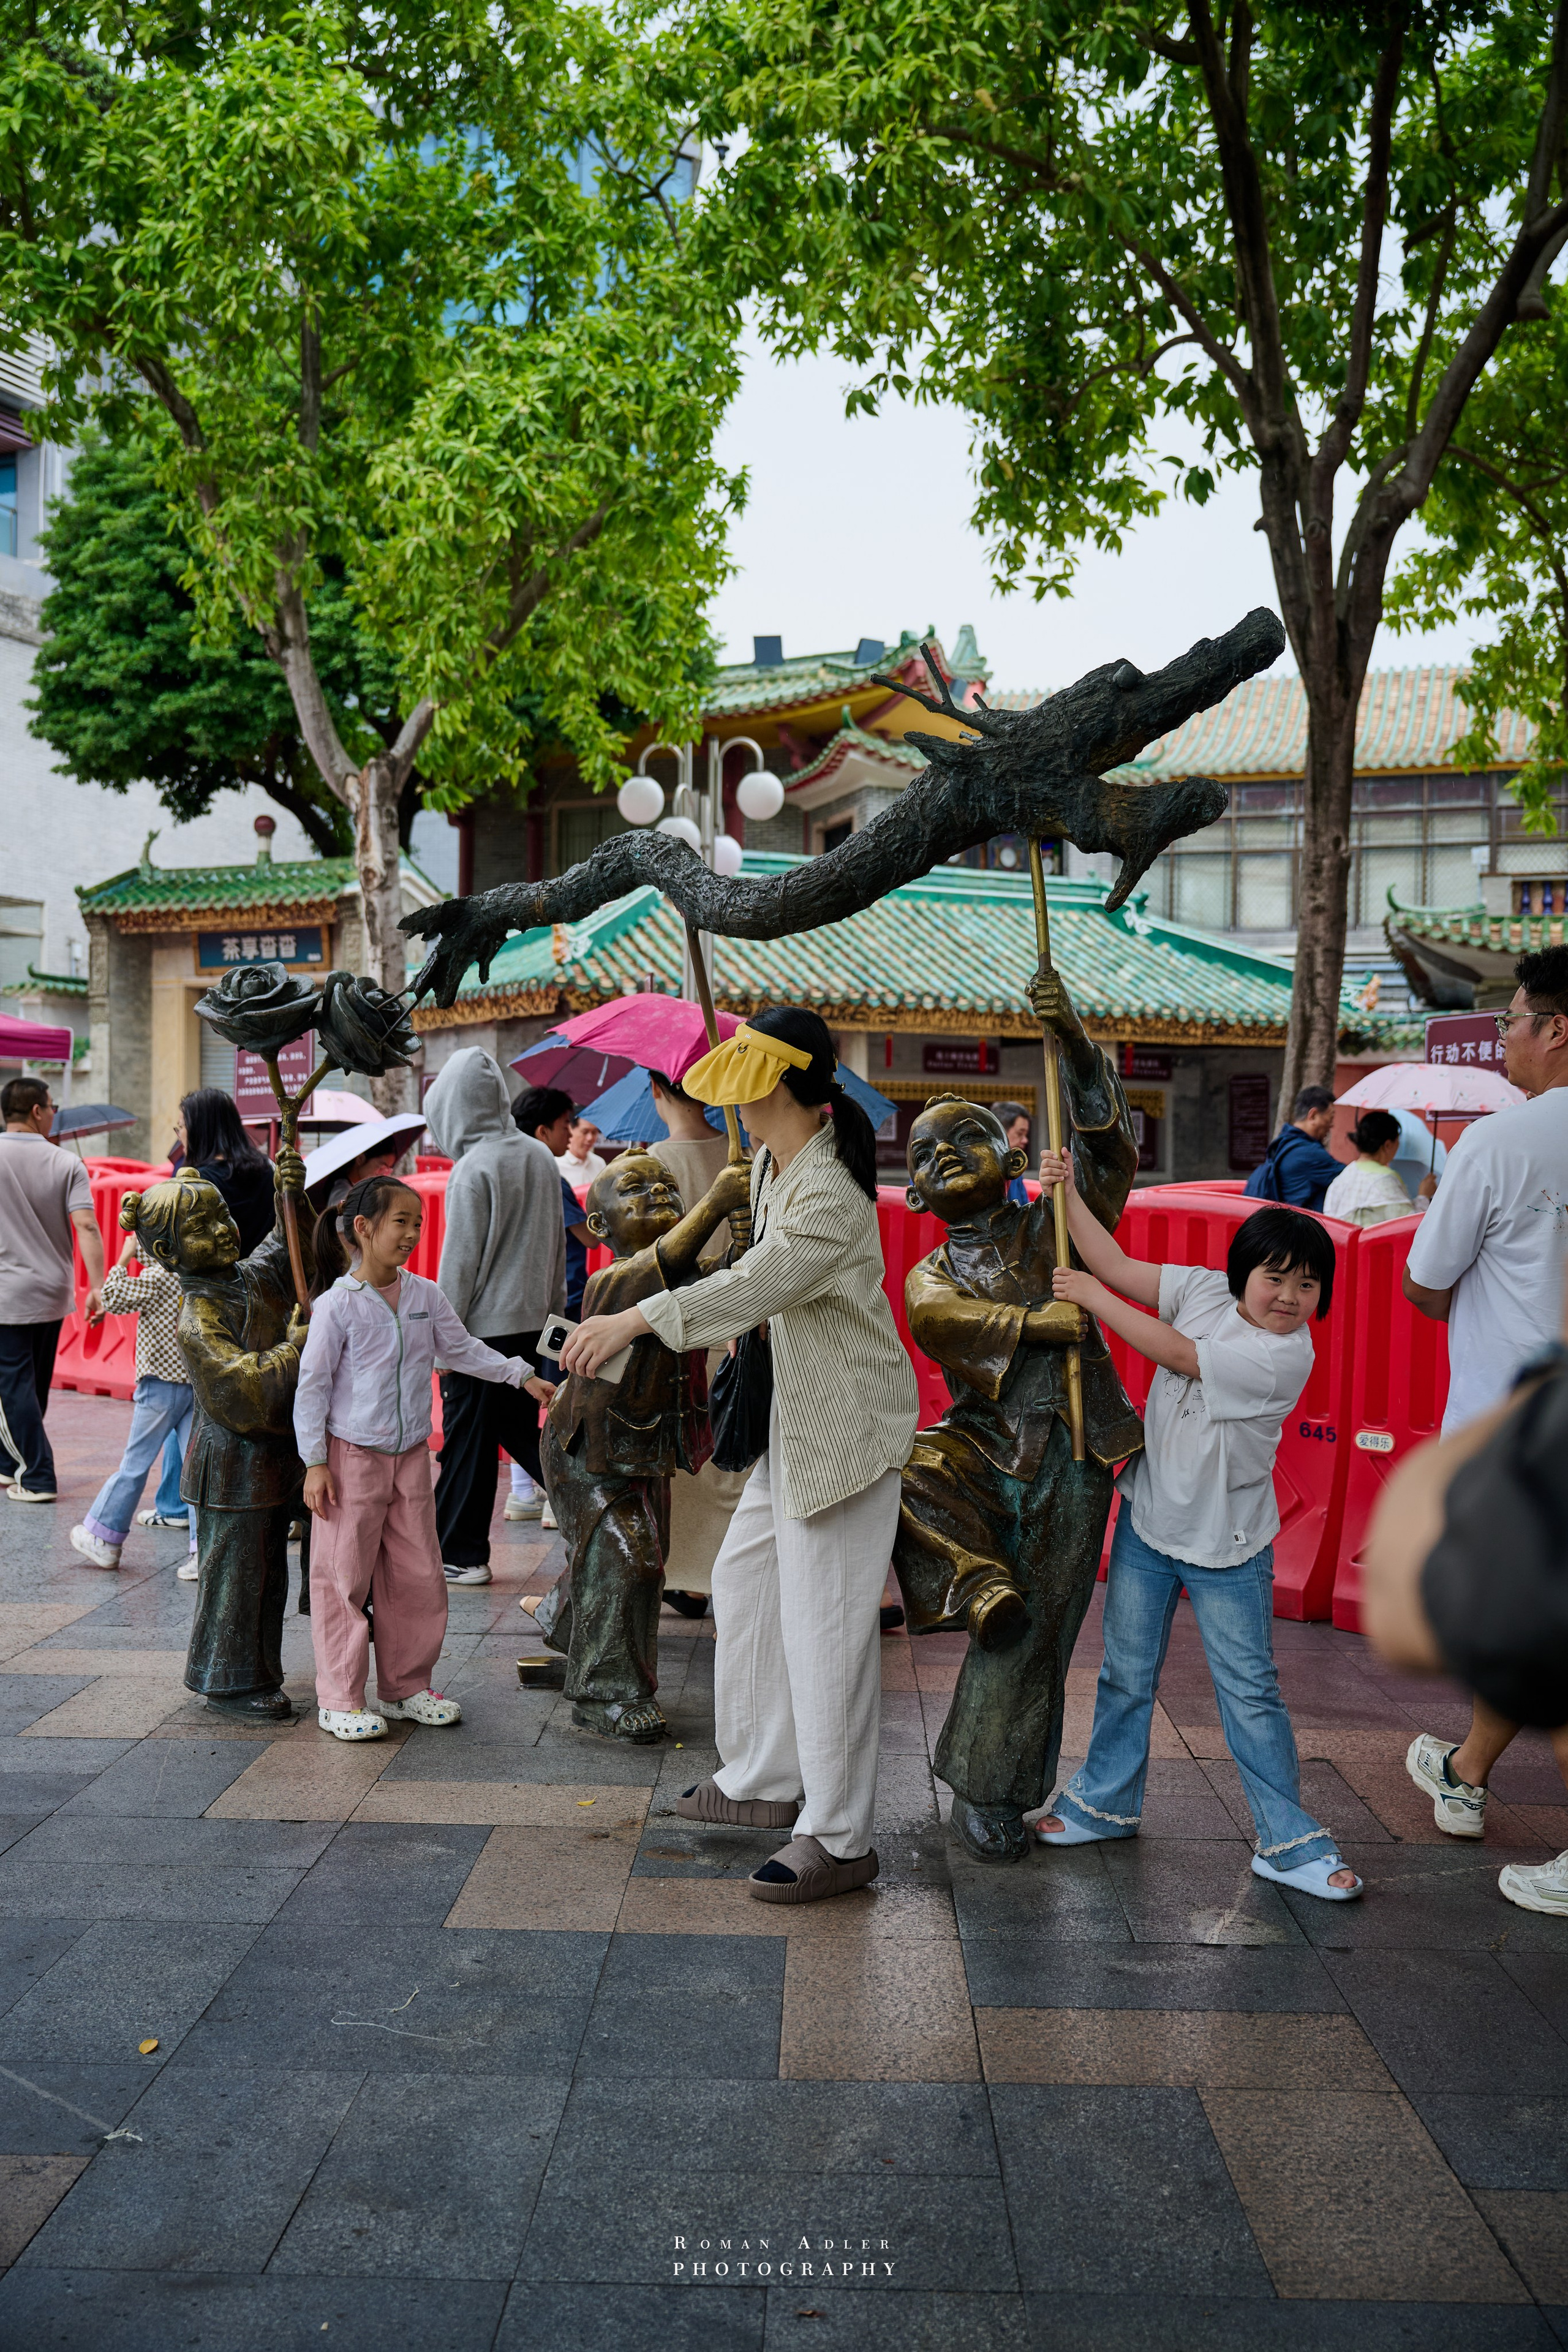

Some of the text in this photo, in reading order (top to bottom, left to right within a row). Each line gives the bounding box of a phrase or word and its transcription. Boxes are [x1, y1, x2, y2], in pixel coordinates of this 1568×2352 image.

[1299, 1422, 1336, 1442] 645
[1359, 1434, 1390, 1449] 爱得乐
